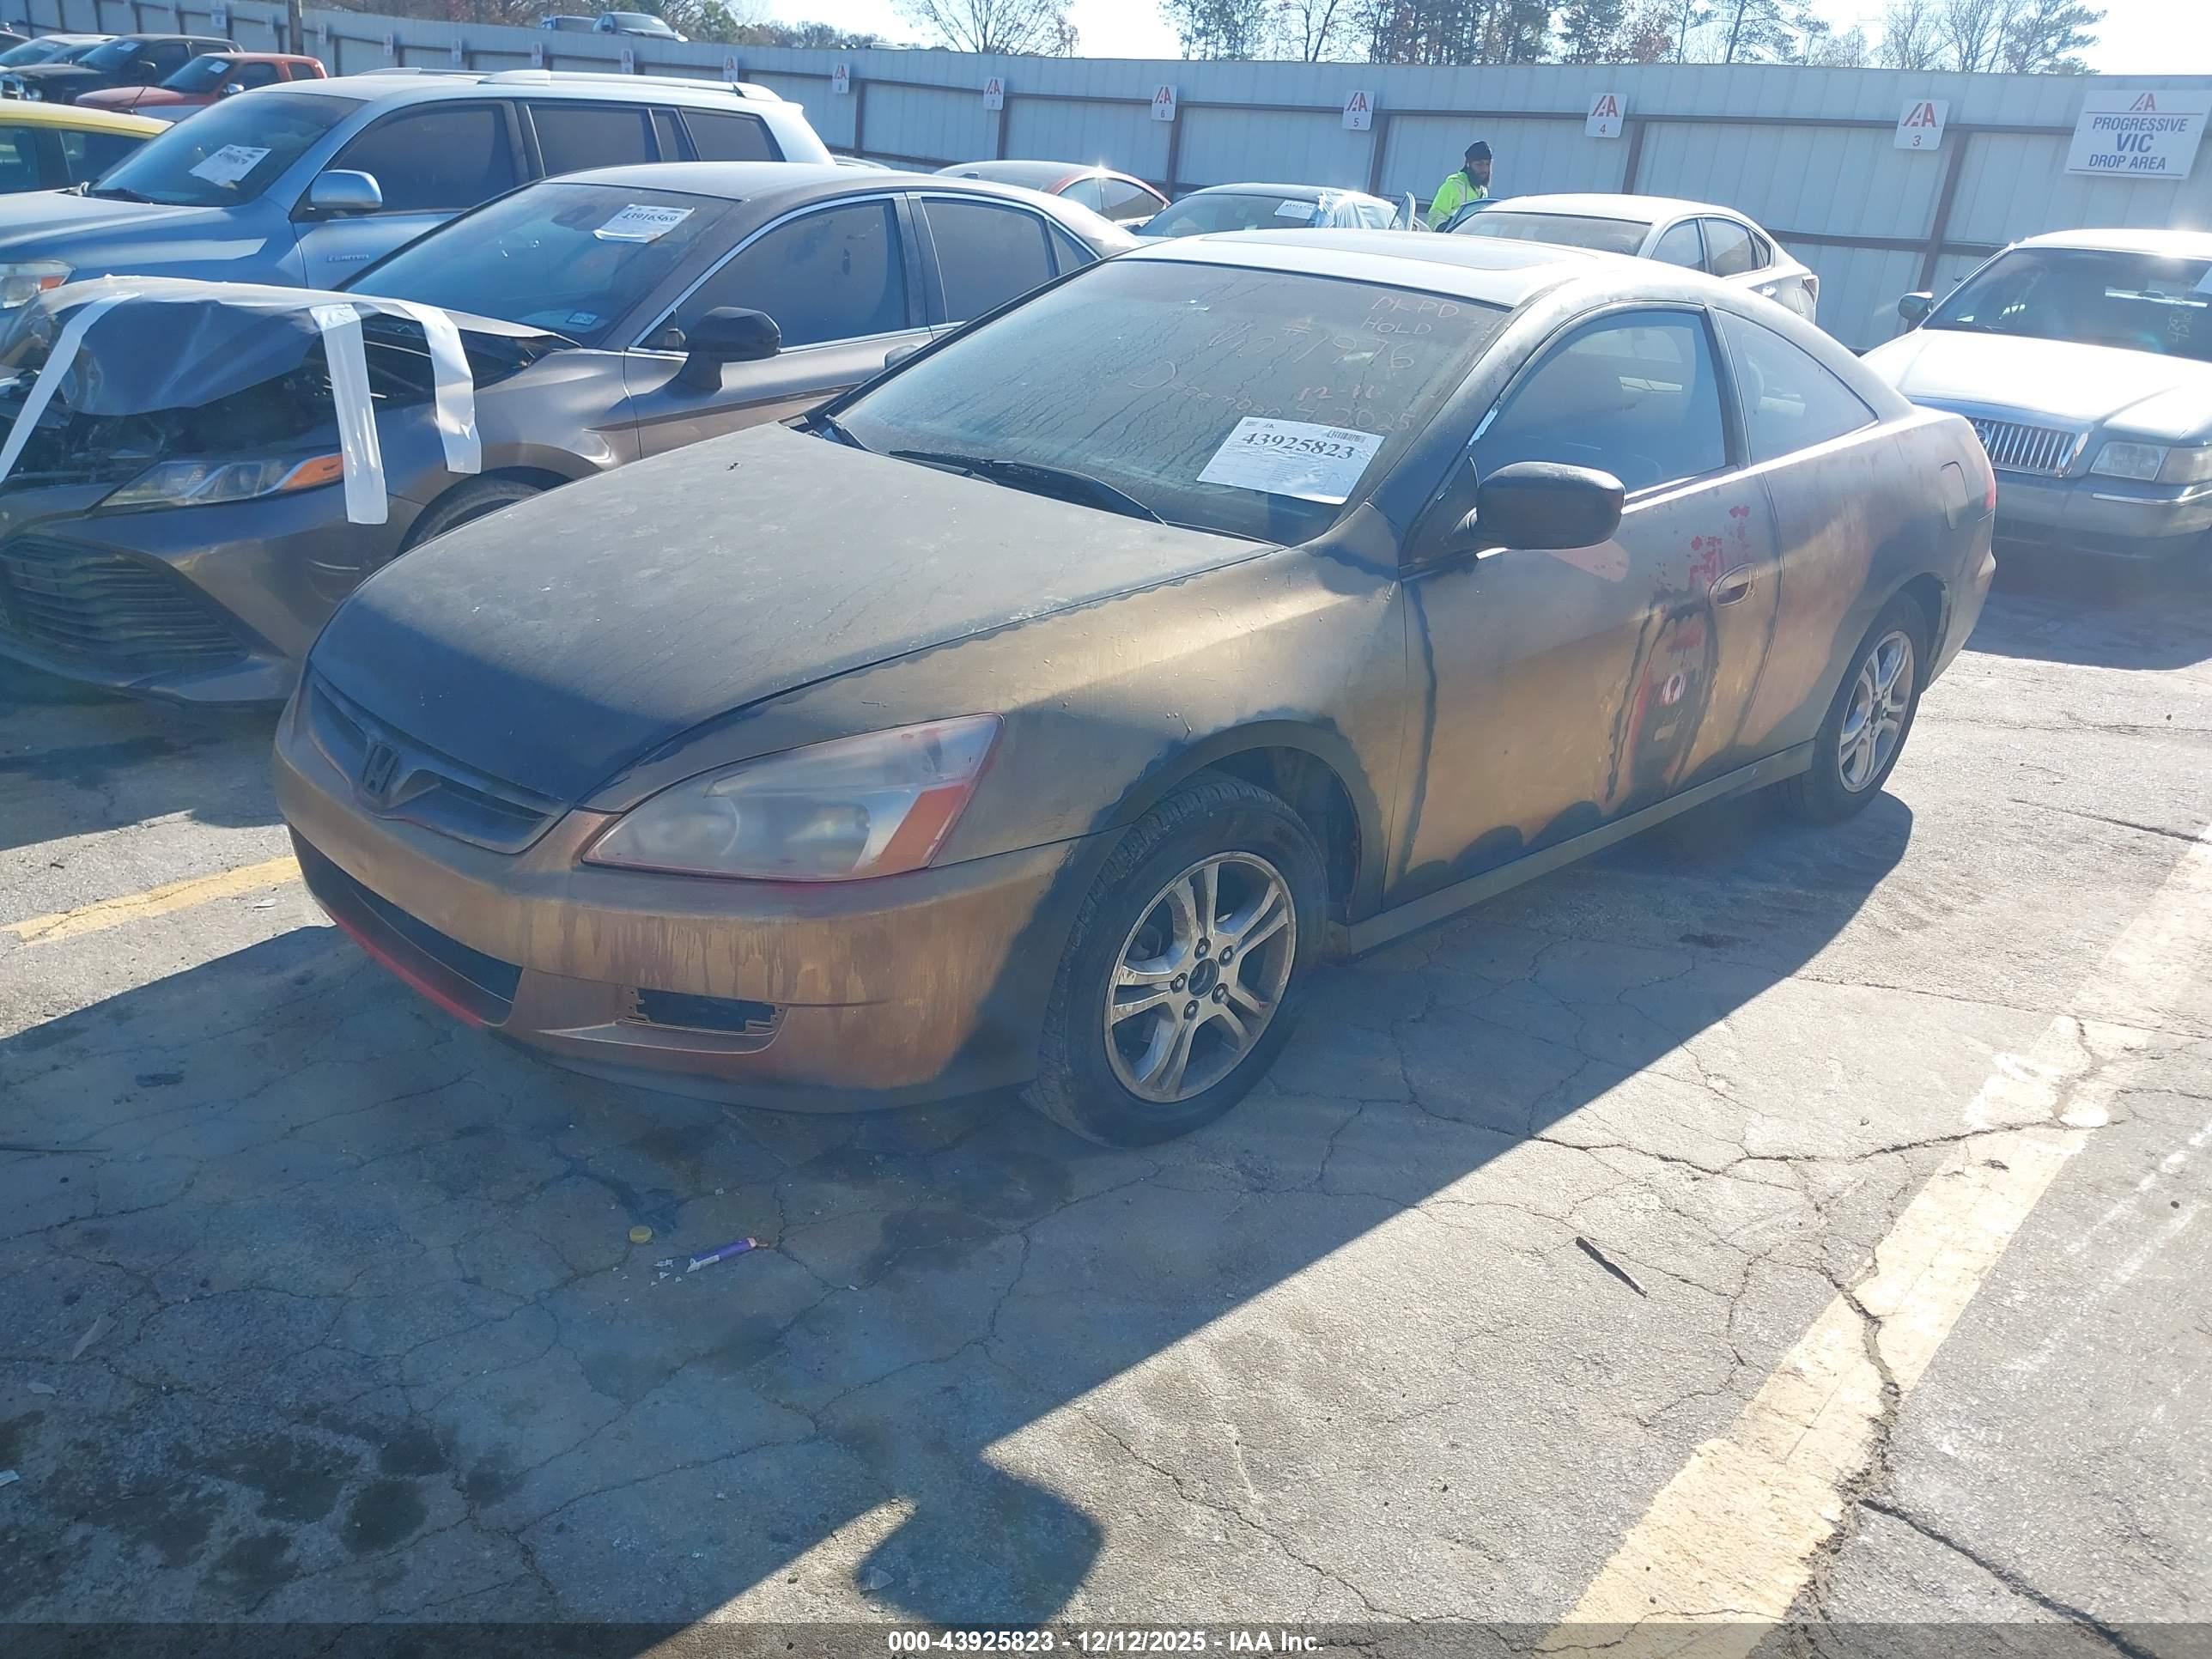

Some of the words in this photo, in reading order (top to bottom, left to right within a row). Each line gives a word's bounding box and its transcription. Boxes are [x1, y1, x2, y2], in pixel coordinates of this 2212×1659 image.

[1160, 109, 1166, 118] 6
[1353, 117, 1360, 128] 5
[1600, 124, 1607, 135] 4
[2092, 117, 2189, 132] PROGRESSIVE
[1912, 135, 1922, 147] 3
[2116, 133, 2154, 153] VIC
[2088, 154, 2126, 168] DROP
[2129, 156, 2166, 171] AREA
[1360, 315, 1432, 335] HOLD
[1242, 432, 1355, 459] 43925823
